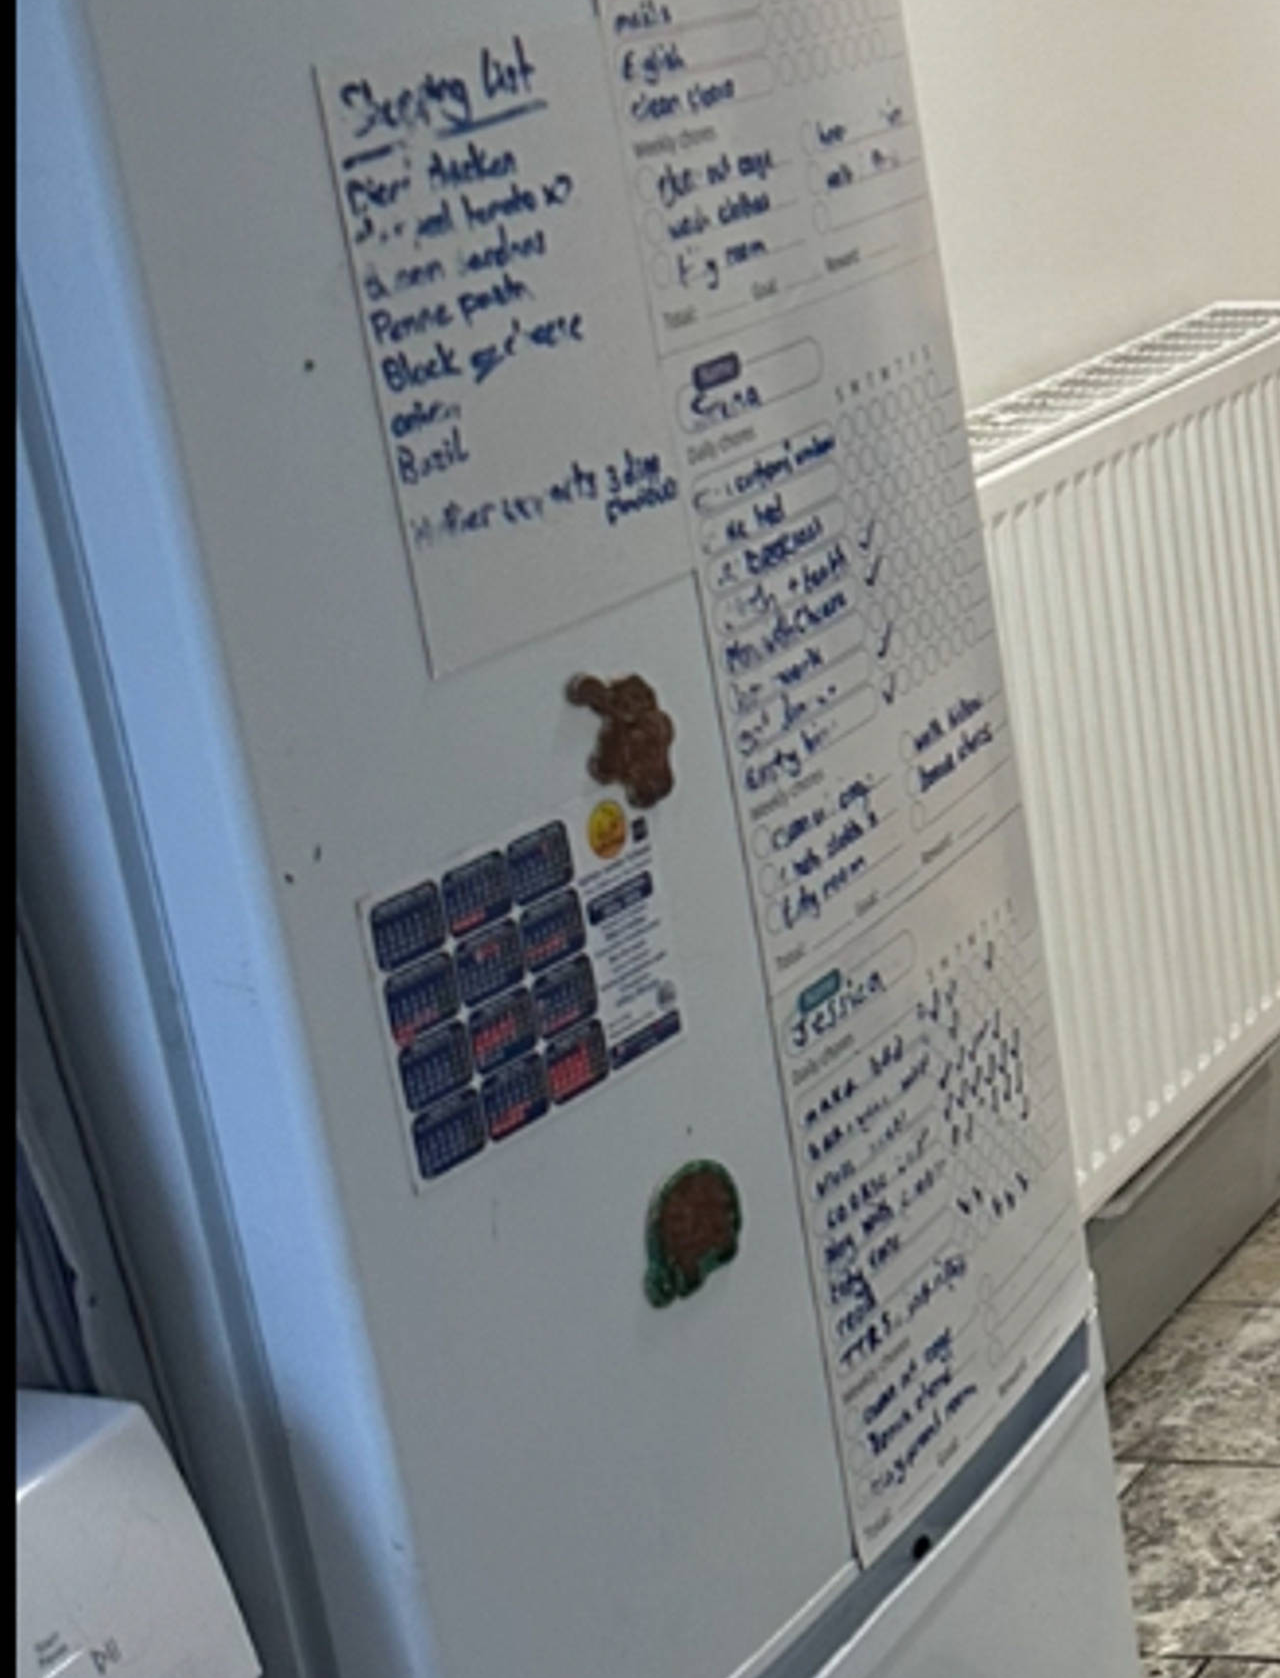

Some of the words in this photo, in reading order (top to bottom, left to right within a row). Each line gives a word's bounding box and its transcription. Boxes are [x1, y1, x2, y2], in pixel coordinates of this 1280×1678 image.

[481, 34, 537, 100] List
[622, 42, 686, 85] Eglish
[788, 970, 888, 1049] Jessica
